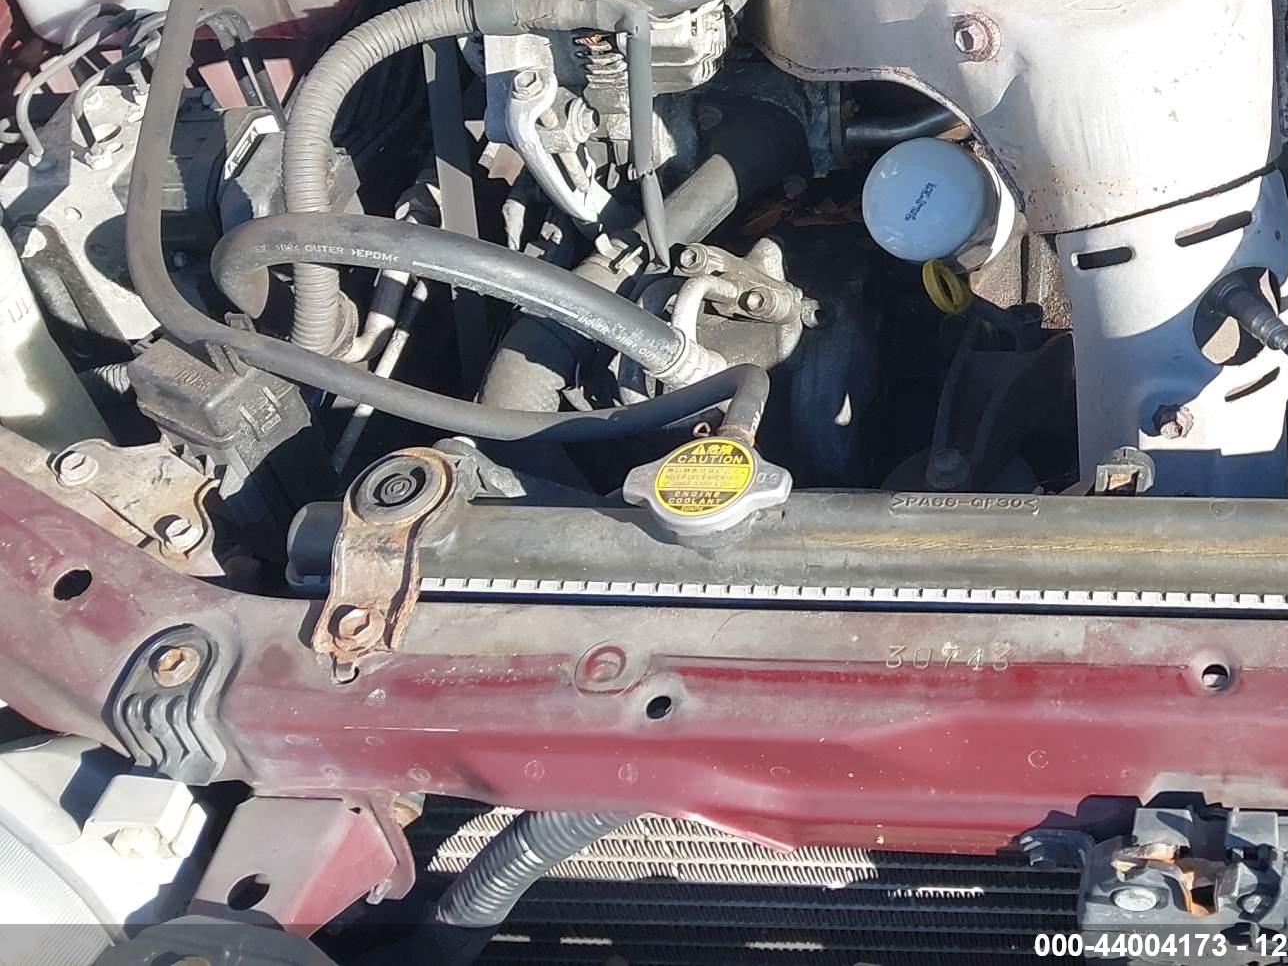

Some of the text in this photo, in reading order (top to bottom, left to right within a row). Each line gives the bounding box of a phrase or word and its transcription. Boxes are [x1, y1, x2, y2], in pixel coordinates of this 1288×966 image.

[304, 243, 345, 255] OUTER
[577, 315, 610, 335] INNER
[677, 455, 744, 464] CAUTION
[668, 497, 722, 505] COOLANT
